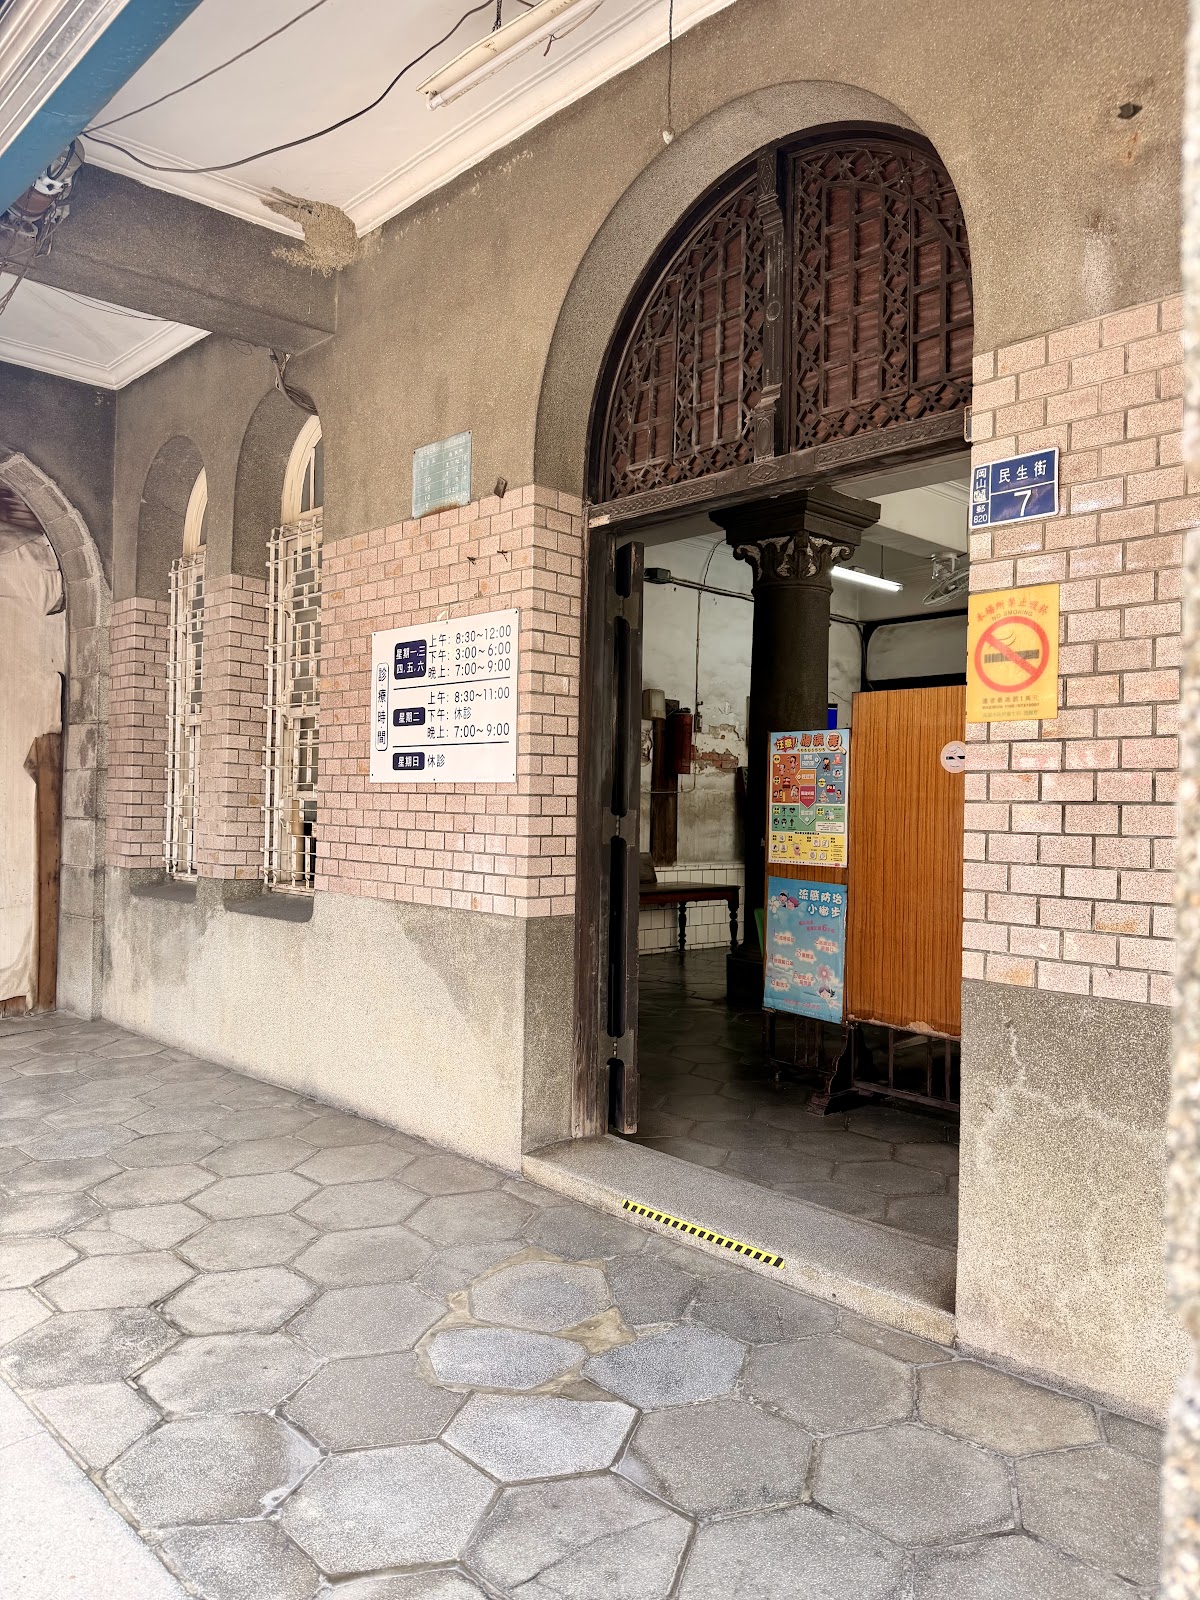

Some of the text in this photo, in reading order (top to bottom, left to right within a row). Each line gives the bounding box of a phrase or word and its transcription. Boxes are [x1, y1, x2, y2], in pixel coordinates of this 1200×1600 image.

[998, 460, 1046, 484] 民生街
[1014, 490, 1031, 516] 7
[974, 514, 987, 524] 820
[1004, 609, 1033, 617] SMOKING
[398, 712, 420, 724] 星期二
[454, 707, 472, 720] 休診
[398, 754, 446, 768] 星期日 休診
[799, 889, 842, 904] 流感防治
[808, 904, 840, 918] 小撇步
